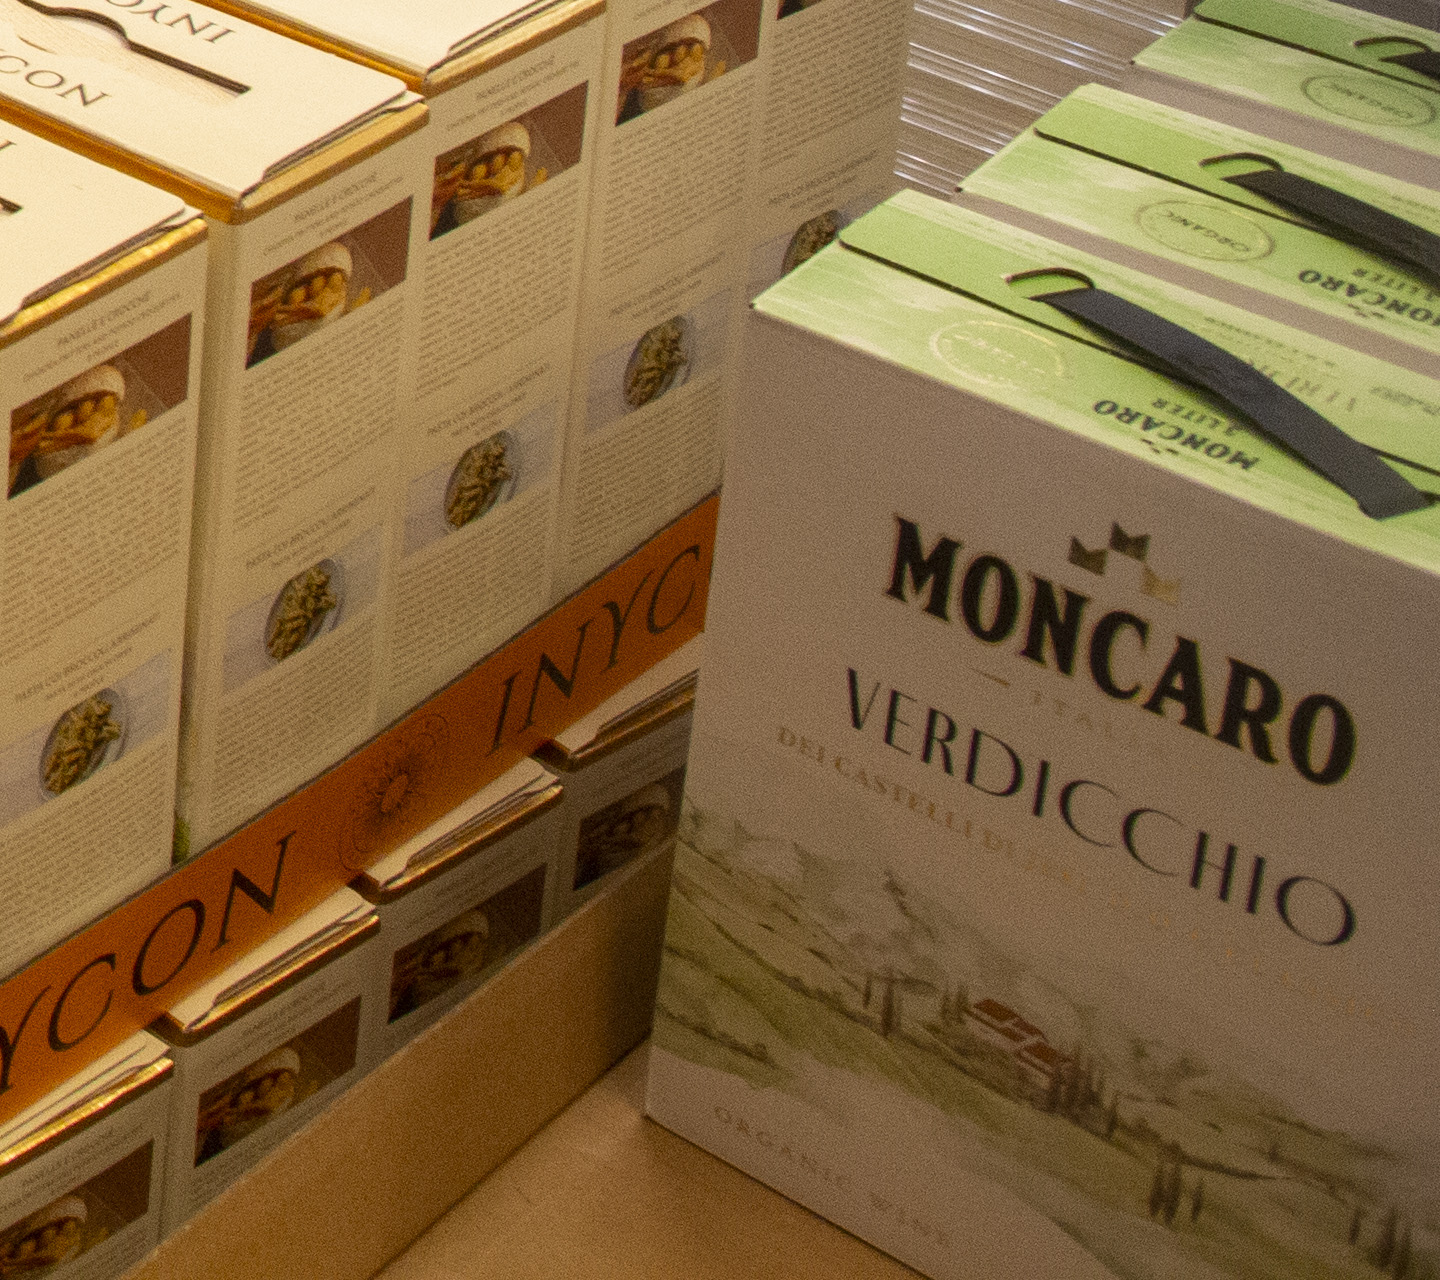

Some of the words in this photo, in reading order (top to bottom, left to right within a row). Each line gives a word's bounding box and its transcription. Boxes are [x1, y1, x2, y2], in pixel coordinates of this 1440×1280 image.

[1093, 397, 1260, 472] MONCARO
[886, 513, 1357, 787] MONCARO
[847, 667, 1357, 947] VERDICCHIO
[713, 1102, 849, 1189] ORGANIC
